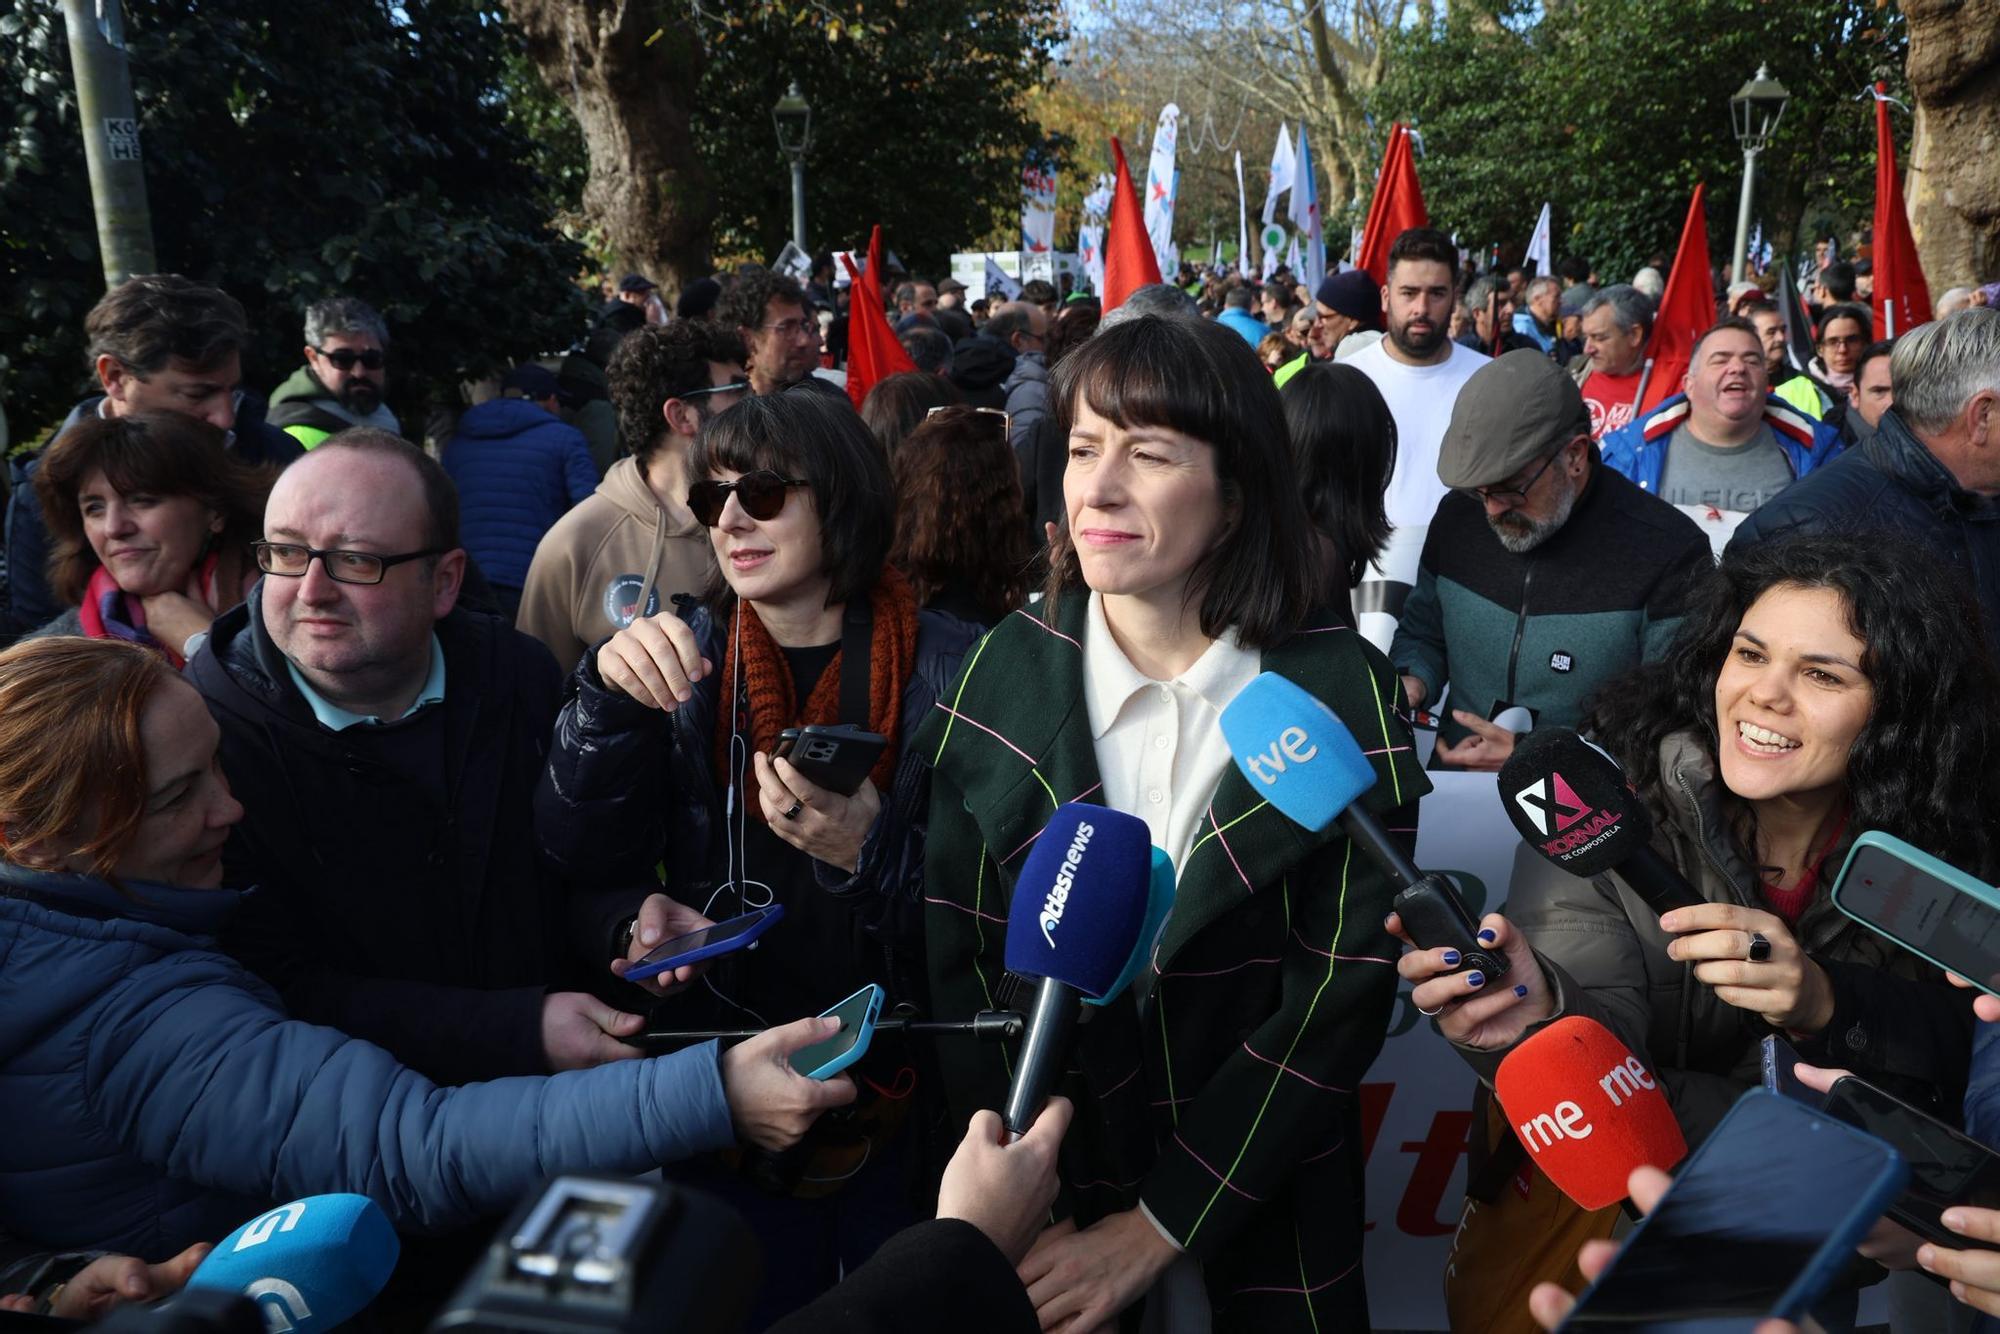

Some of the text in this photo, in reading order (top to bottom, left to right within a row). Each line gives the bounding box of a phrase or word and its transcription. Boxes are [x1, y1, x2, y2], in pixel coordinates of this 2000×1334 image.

[1246, 726, 1318, 785] tve
[1540, 808, 1623, 857] XORNAL
[1560, 825, 1622, 862] DE COMPOSTELA
[1599, 1056, 1656, 1106] rne
[1520, 1100, 1593, 1153] rne
